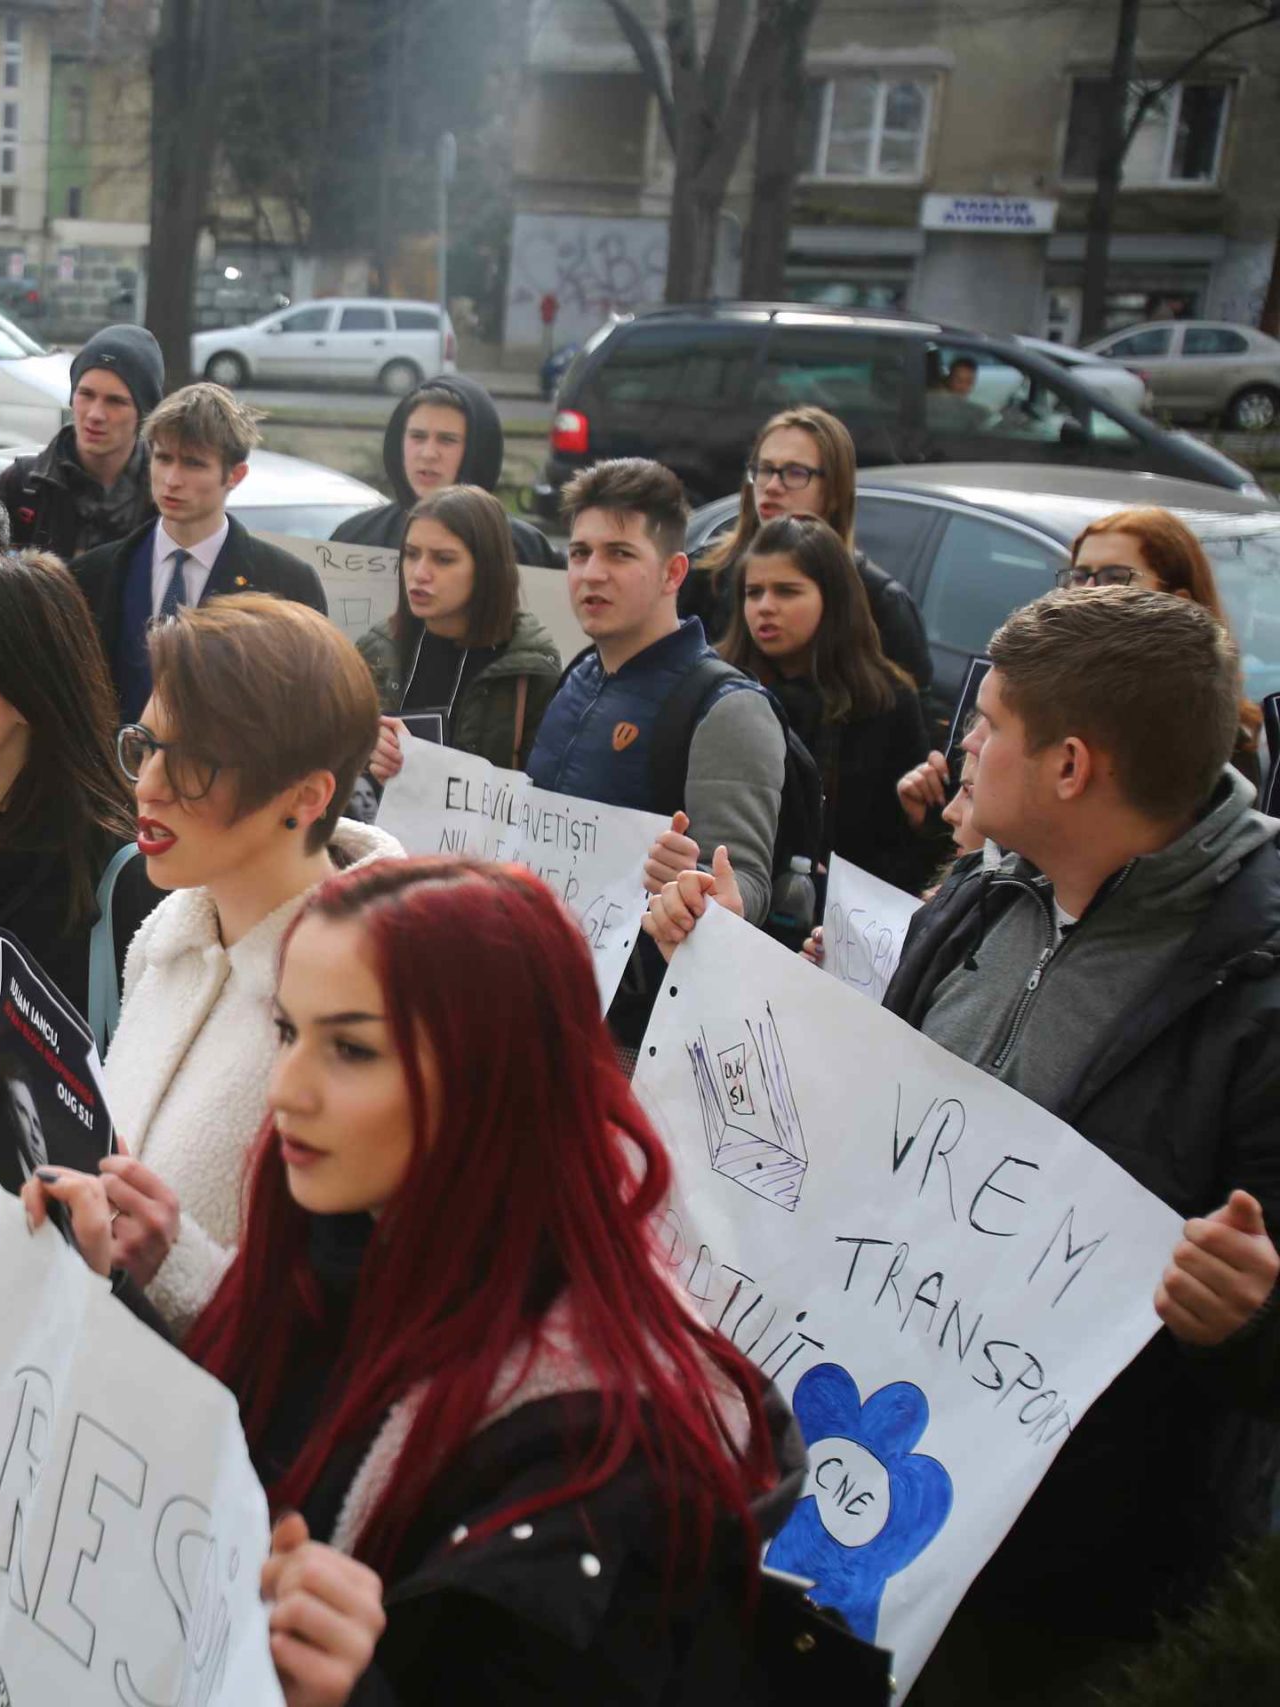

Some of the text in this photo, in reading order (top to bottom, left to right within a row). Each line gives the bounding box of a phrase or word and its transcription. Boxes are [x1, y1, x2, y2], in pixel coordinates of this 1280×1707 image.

[9, 976, 61, 1055] IULIAN IANCU,
[57, 1082, 94, 1131] OUG 51!
[891, 1082, 1109, 1309] VREM
[816, 1457, 875, 1516] CNE
